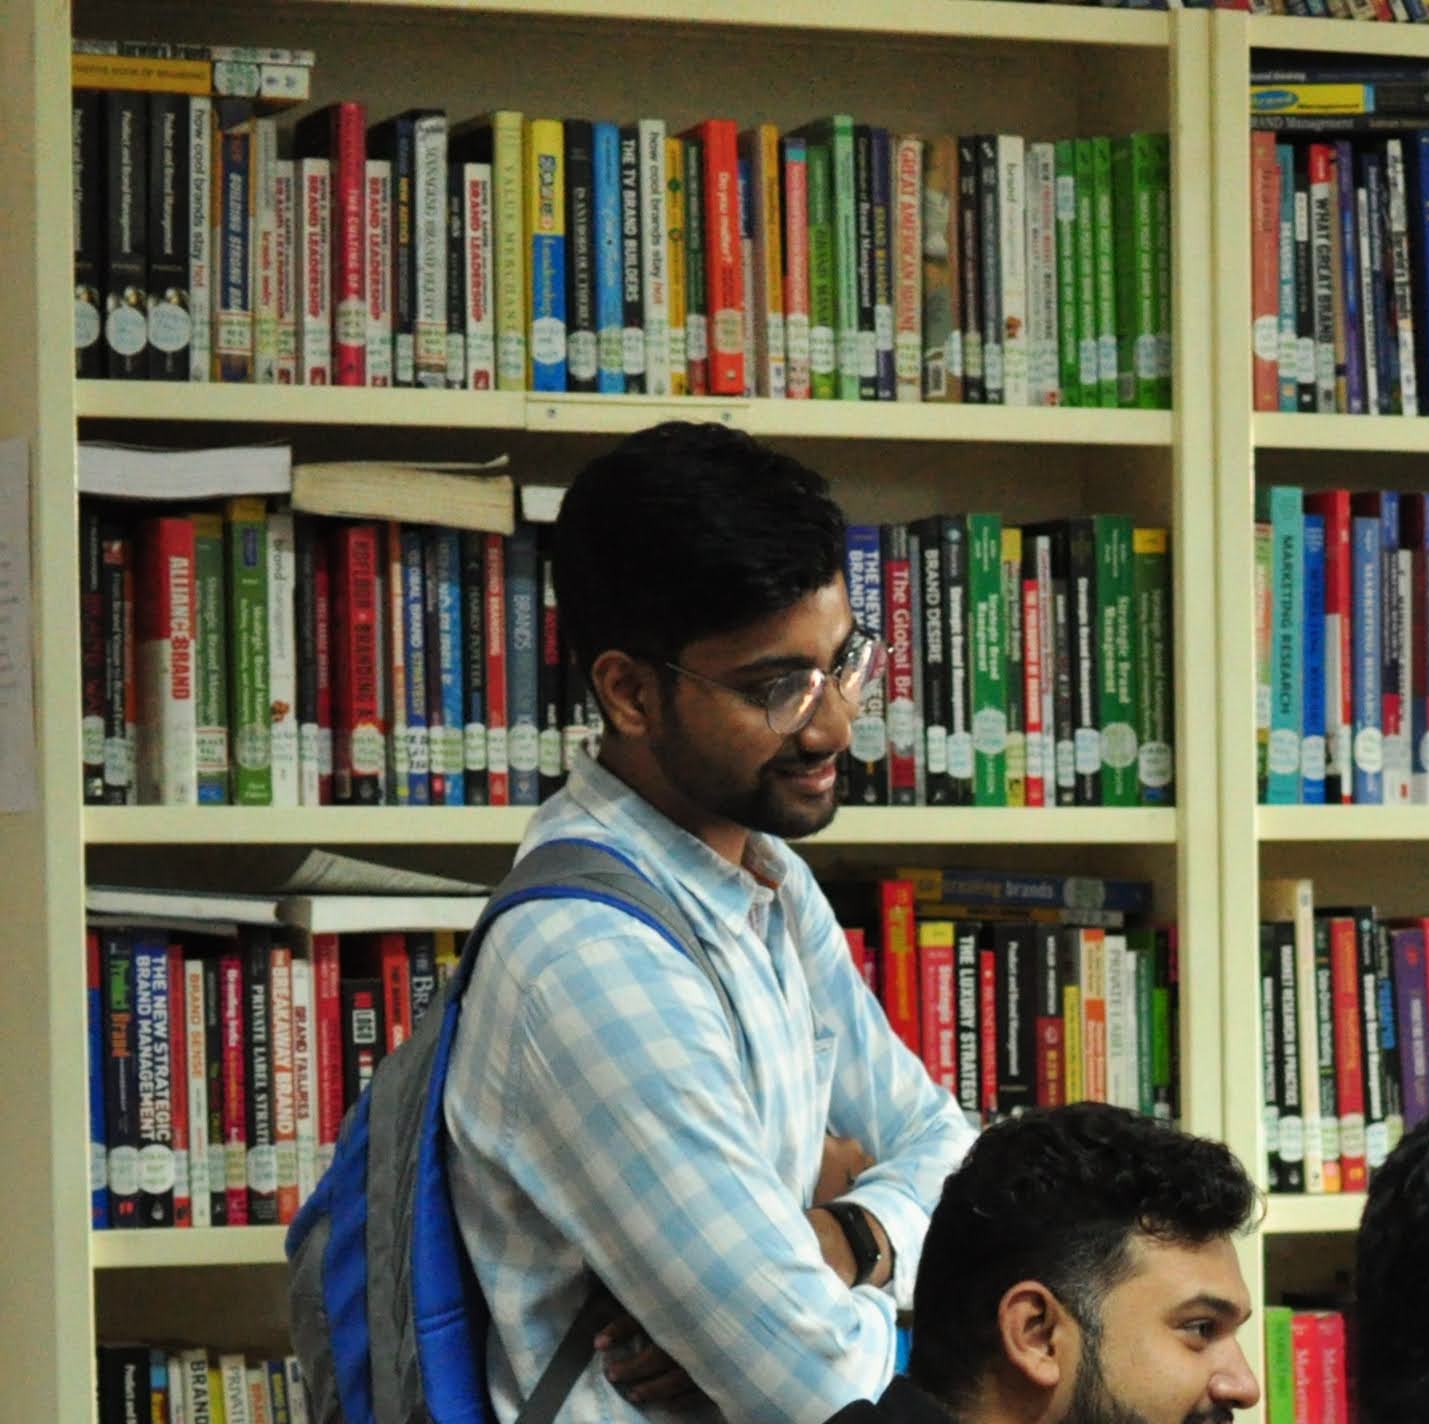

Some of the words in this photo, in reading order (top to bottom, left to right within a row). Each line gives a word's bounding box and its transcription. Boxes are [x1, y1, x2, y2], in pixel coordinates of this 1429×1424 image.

[193, 109, 205, 141] how
[648, 131, 660, 161] how
[193, 144, 206, 174] cool
[622, 140, 636, 165] THE
[307, 175, 318, 227] BRAND
[623, 169, 636, 186] TV
[649, 165, 662, 194] cool
[193, 178, 206, 227] brands
[368, 177, 380, 229] BRAND
[470, 180, 482, 232] BRAND
[623, 190, 637, 235] BRAND
[650, 198, 663, 246] brands
[1315, 198, 1329, 241] WHAT
[189, 232, 204, 260] stay
[649, 250, 662, 279] stay
[1316, 245, 1330, 289] GREAT
[193, 265, 206, 288] hot
[308, 232, 319, 317] LEADERSHIP
[368, 234, 380, 320] LEADERSHIP
[471, 236, 483, 322] LEADERSHIP
[625, 239, 639, 303] BUILDERS
[864, 550, 879, 584] THE
[892, 568, 908, 602] The
[925, 549, 941, 605] BRAND
[1280, 534, 1294, 628] MARKETING
[864, 588, 879, 629] NEW
[1117, 596, 1131, 658] Strategic
[892, 608, 910, 669] Global
[927, 608, 943, 664] DESIRE
[1118, 662, 1131, 703] Brand
[1280, 633, 1293, 715] RESEARCH
[151, 955, 167, 992] THE
[959, 935, 974, 965] THE
[135, 955, 153, 1016] BRAND
[189, 973, 201, 1026] BRAND
[959, 968, 975, 1030] LUXURY
[152, 996, 167, 1040] NEW
[251, 984, 266, 1043] PRIVATE
[272, 966, 289, 1067] BREAKAWAY
[295, 1006, 309, 1054] BRAND
[191, 1031, 203, 1079] SENSE
[253, 1046, 267, 1089] LABEL
[960, 1032, 977, 1111] STRATEGY
[138, 1019, 156, 1141] MANAGEMENT
[153, 1042, 170, 1141] STRATEGIC
[276, 1072, 293, 1133] BRAND
[255, 1093, 270, 1145] STRATE
